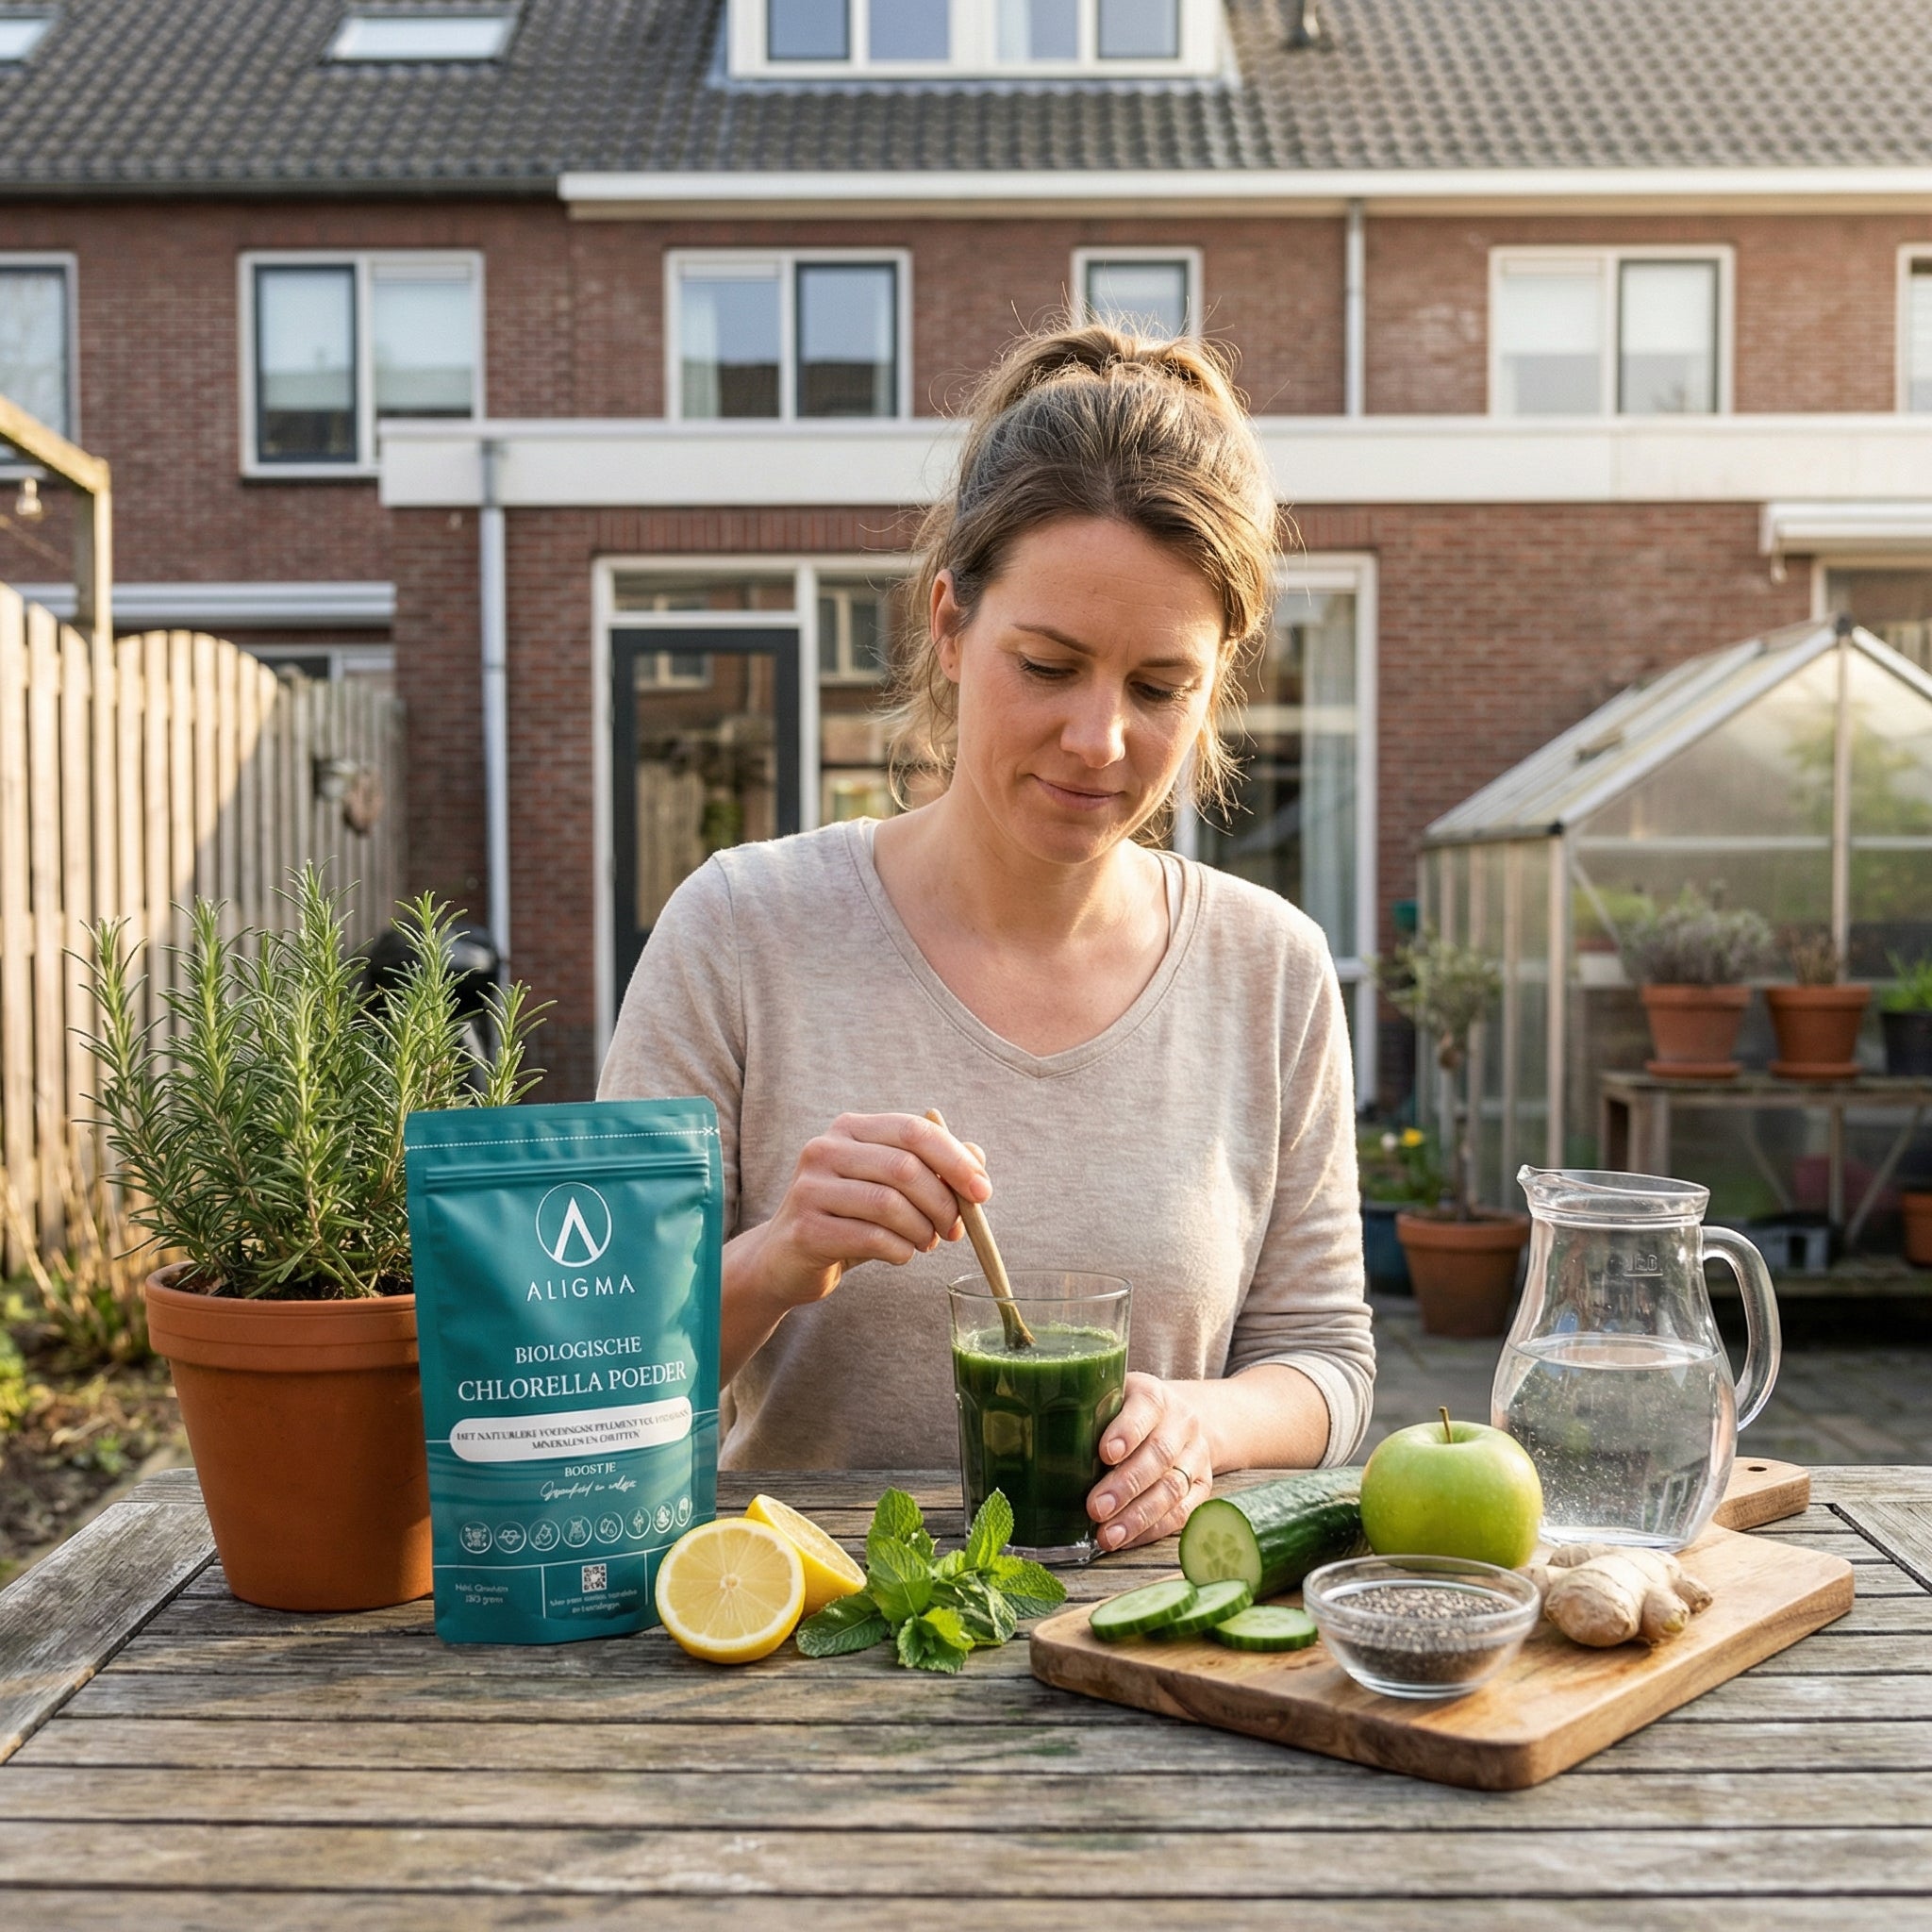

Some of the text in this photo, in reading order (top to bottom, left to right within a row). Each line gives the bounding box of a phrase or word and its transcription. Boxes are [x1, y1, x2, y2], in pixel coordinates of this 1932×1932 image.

[526, 1274, 636, 1302] ALIGMA
[515, 1336, 642, 1364] BIOLOGISCHE
[458, 1360, 688, 1402] CHLORELLA POEDER
[564, 1461, 617, 1477] BOOST JE
